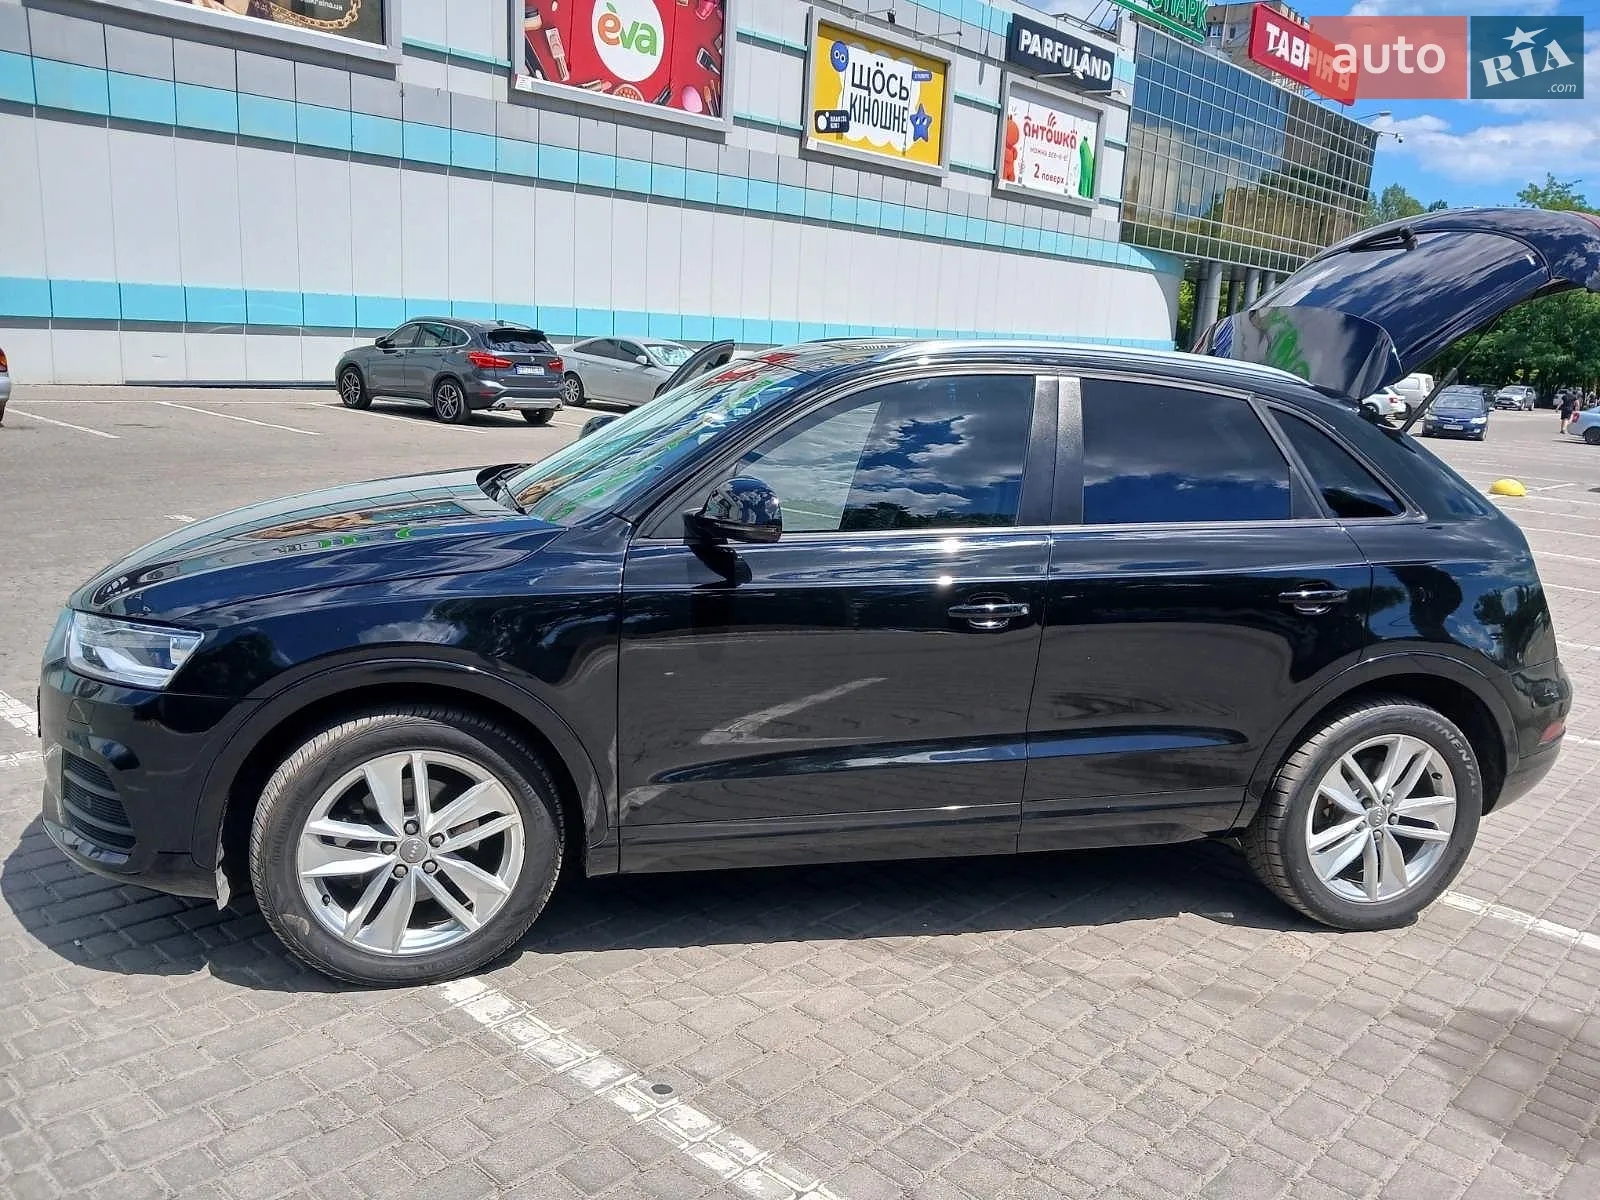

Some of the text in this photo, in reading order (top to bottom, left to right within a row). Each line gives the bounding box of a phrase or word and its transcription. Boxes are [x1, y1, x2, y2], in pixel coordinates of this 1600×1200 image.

[849, 92, 908, 135] КІНОШНЕ
[1033, 163, 1065, 184] 2 поверх
